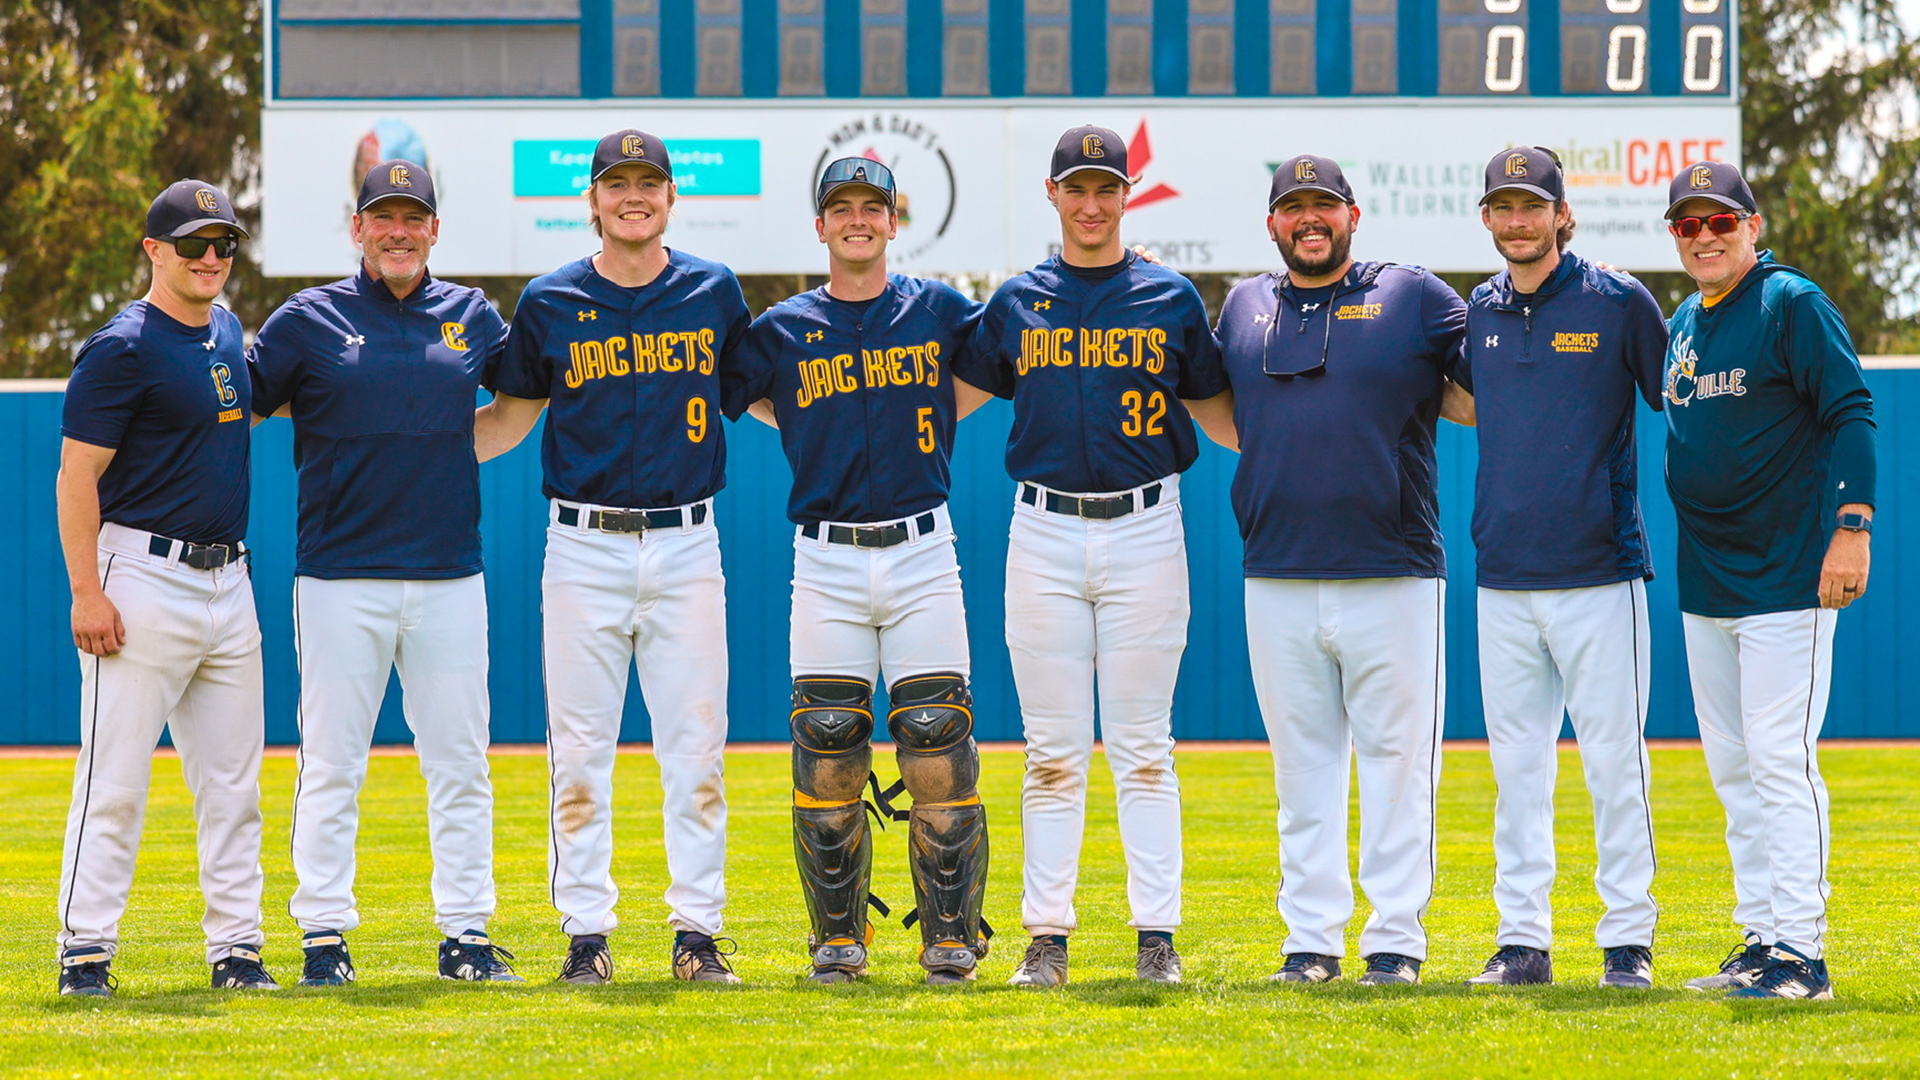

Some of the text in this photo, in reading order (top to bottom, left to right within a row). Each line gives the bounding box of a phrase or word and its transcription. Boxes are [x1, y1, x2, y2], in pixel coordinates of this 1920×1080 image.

[1484, 25, 1723, 91] 0 0 0
[1335, 303, 1383, 316] JACKETS
[564, 327, 715, 389] JACKETS
[1016, 327, 1168, 376] JACKETS
[1551, 332, 1600, 348] JACKETS
[796, 340, 941, 408] JACKETS
[685, 396, 707, 443] 9
[916, 407, 936, 454] 5
[1120, 390, 1168, 437] 32
